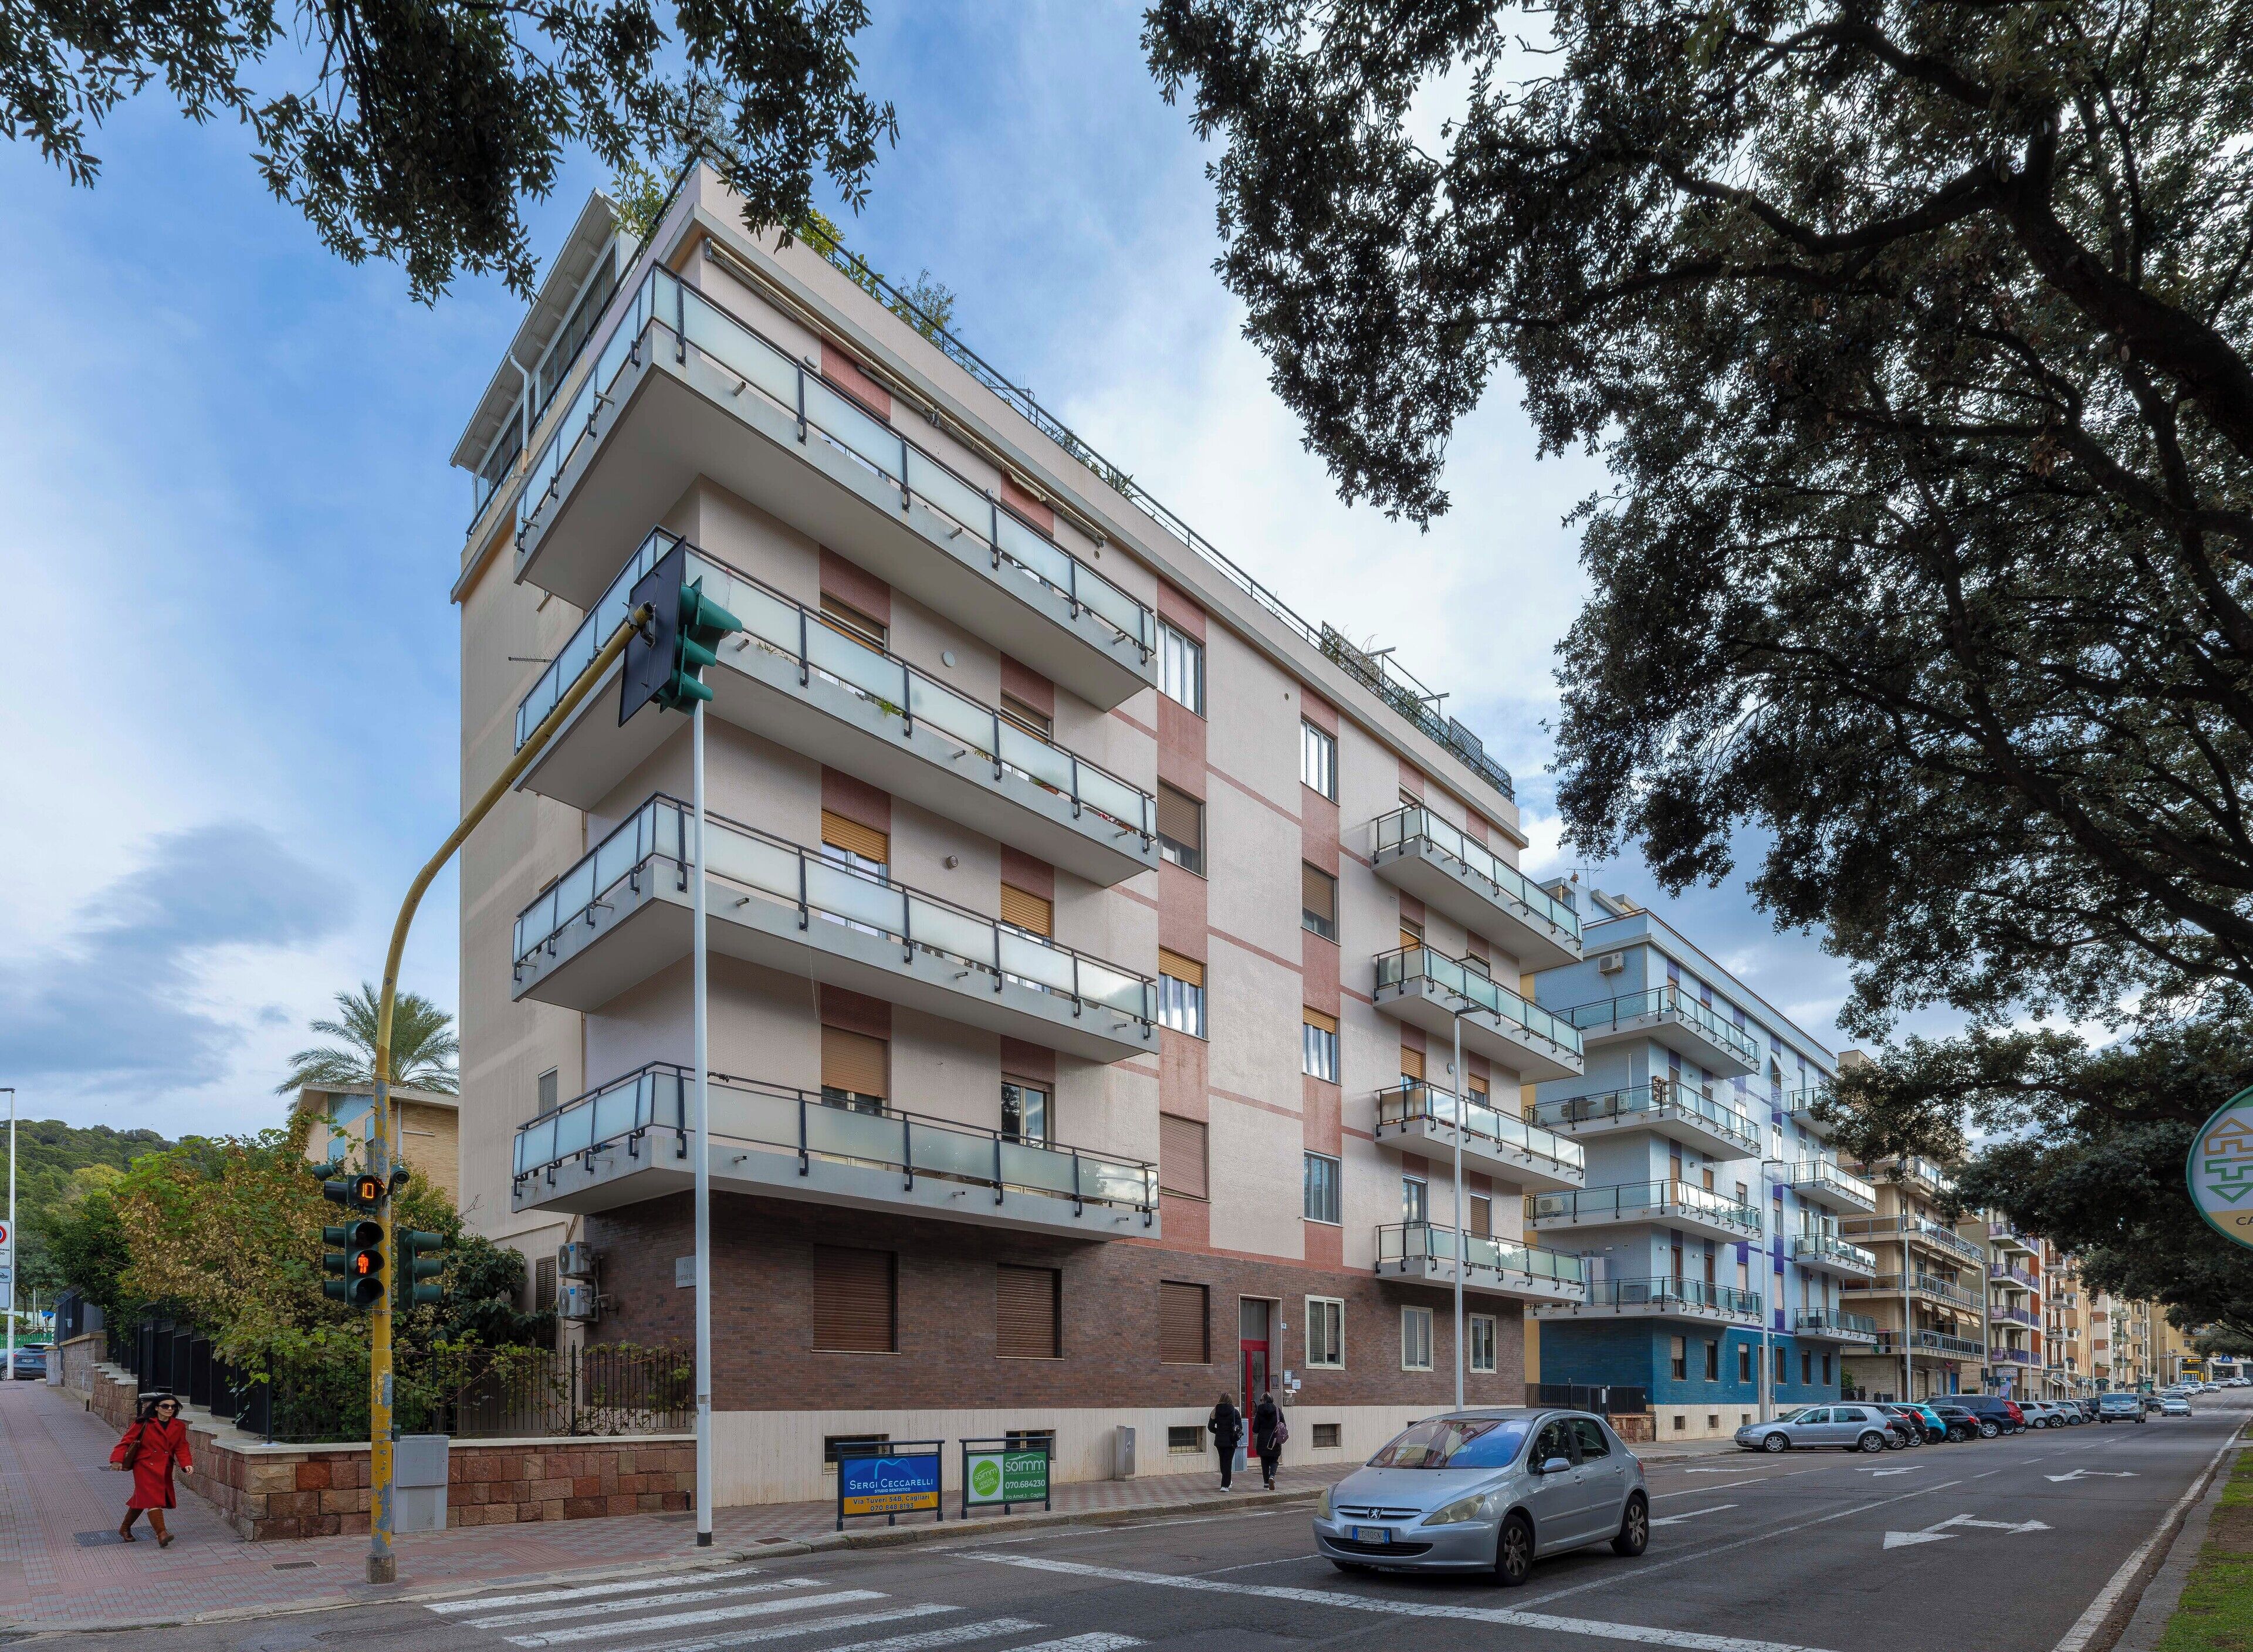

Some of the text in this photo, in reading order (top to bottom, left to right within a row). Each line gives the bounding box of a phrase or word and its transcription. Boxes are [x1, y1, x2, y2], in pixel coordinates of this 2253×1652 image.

[362, 1183, 374, 1198] 10
[850, 1478, 933, 1489] SERGI CECCARELLI
[1005, 1480, 1046, 1489] 070.684230
